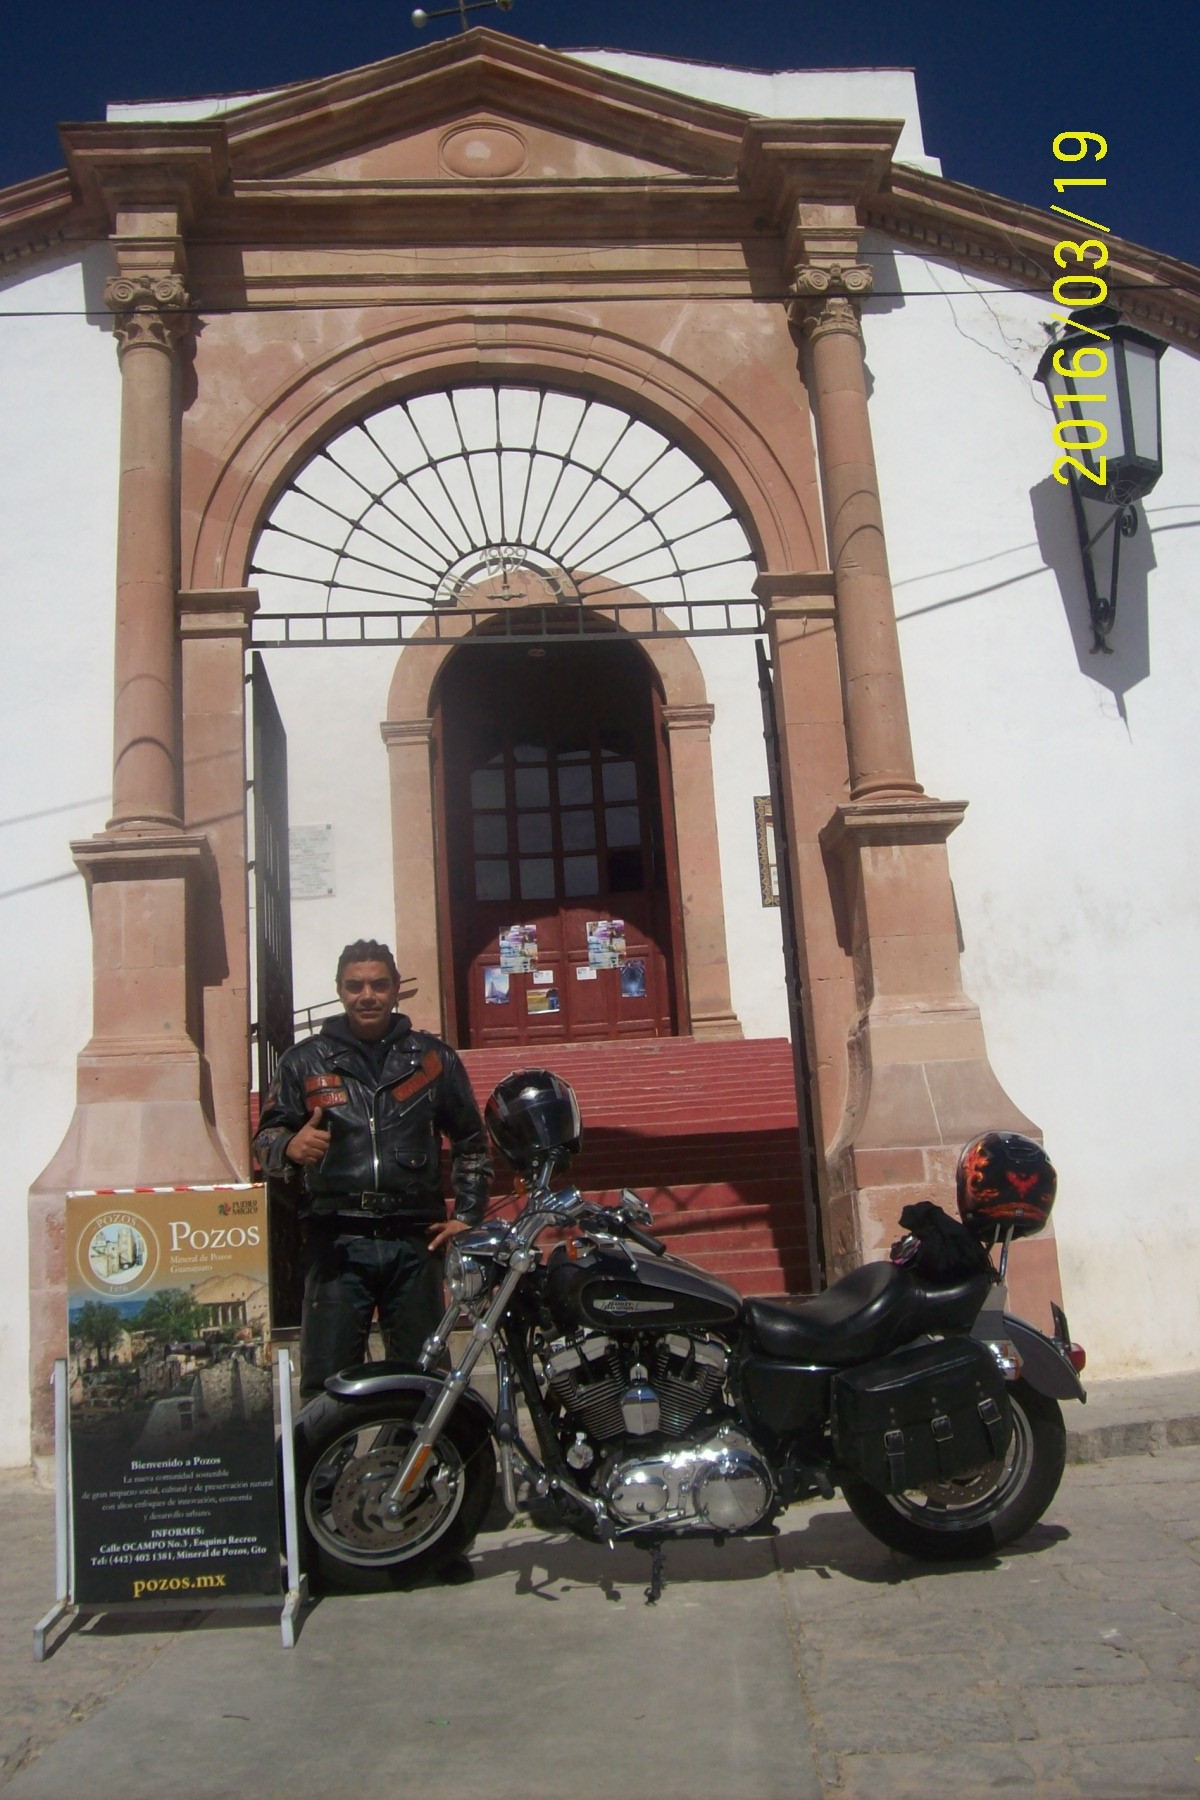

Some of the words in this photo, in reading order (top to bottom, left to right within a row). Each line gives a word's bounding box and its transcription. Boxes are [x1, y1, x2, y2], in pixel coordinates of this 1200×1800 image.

[95, 1213, 137, 1228] POZOS
[170, 1255, 198, 1264] Mineral
[199, 1254, 208, 1262] de
[131, 1458, 183, 1470] Bienvenido
[193, 1456, 221, 1466] Pozos
[123, 1476, 132, 1484] La
[155, 1472, 194, 1481] comunidad
[195, 1469, 229, 1478] sostenible
[81, 1491, 90, 1500] de
[91, 1492, 108, 1501] gran
[109, 1488, 137, 1499] impacto
[161, 1484, 187, 1494] cultural
[194, 1483, 203, 1492] de
[249, 1478, 274, 1488] natural
[167, 1498, 176, 1506] de
[149, 1510, 184, 1520] desarrollo
[151, 1526, 205, 1538] INFORMES:
[100, 1543, 121, 1553] Calle
[122, 1541, 166, 1551] OCAMPO
[193, 1537, 227, 1548] Esquina
[228, 1535, 257, 1544] Recreo
[91, 1556, 108, 1566] Tel:
[109, 1554, 133, 1566] (442)
[134, 1553, 151, 1562] 402
[176, 1549, 209, 1559] Mineral
[210, 1548, 220, 1557] de
[222, 1546, 249, 1556] Pozos,
[250, 1545, 267, 1554] Gto
[133, 1574, 226, 1598] pozos.mx
